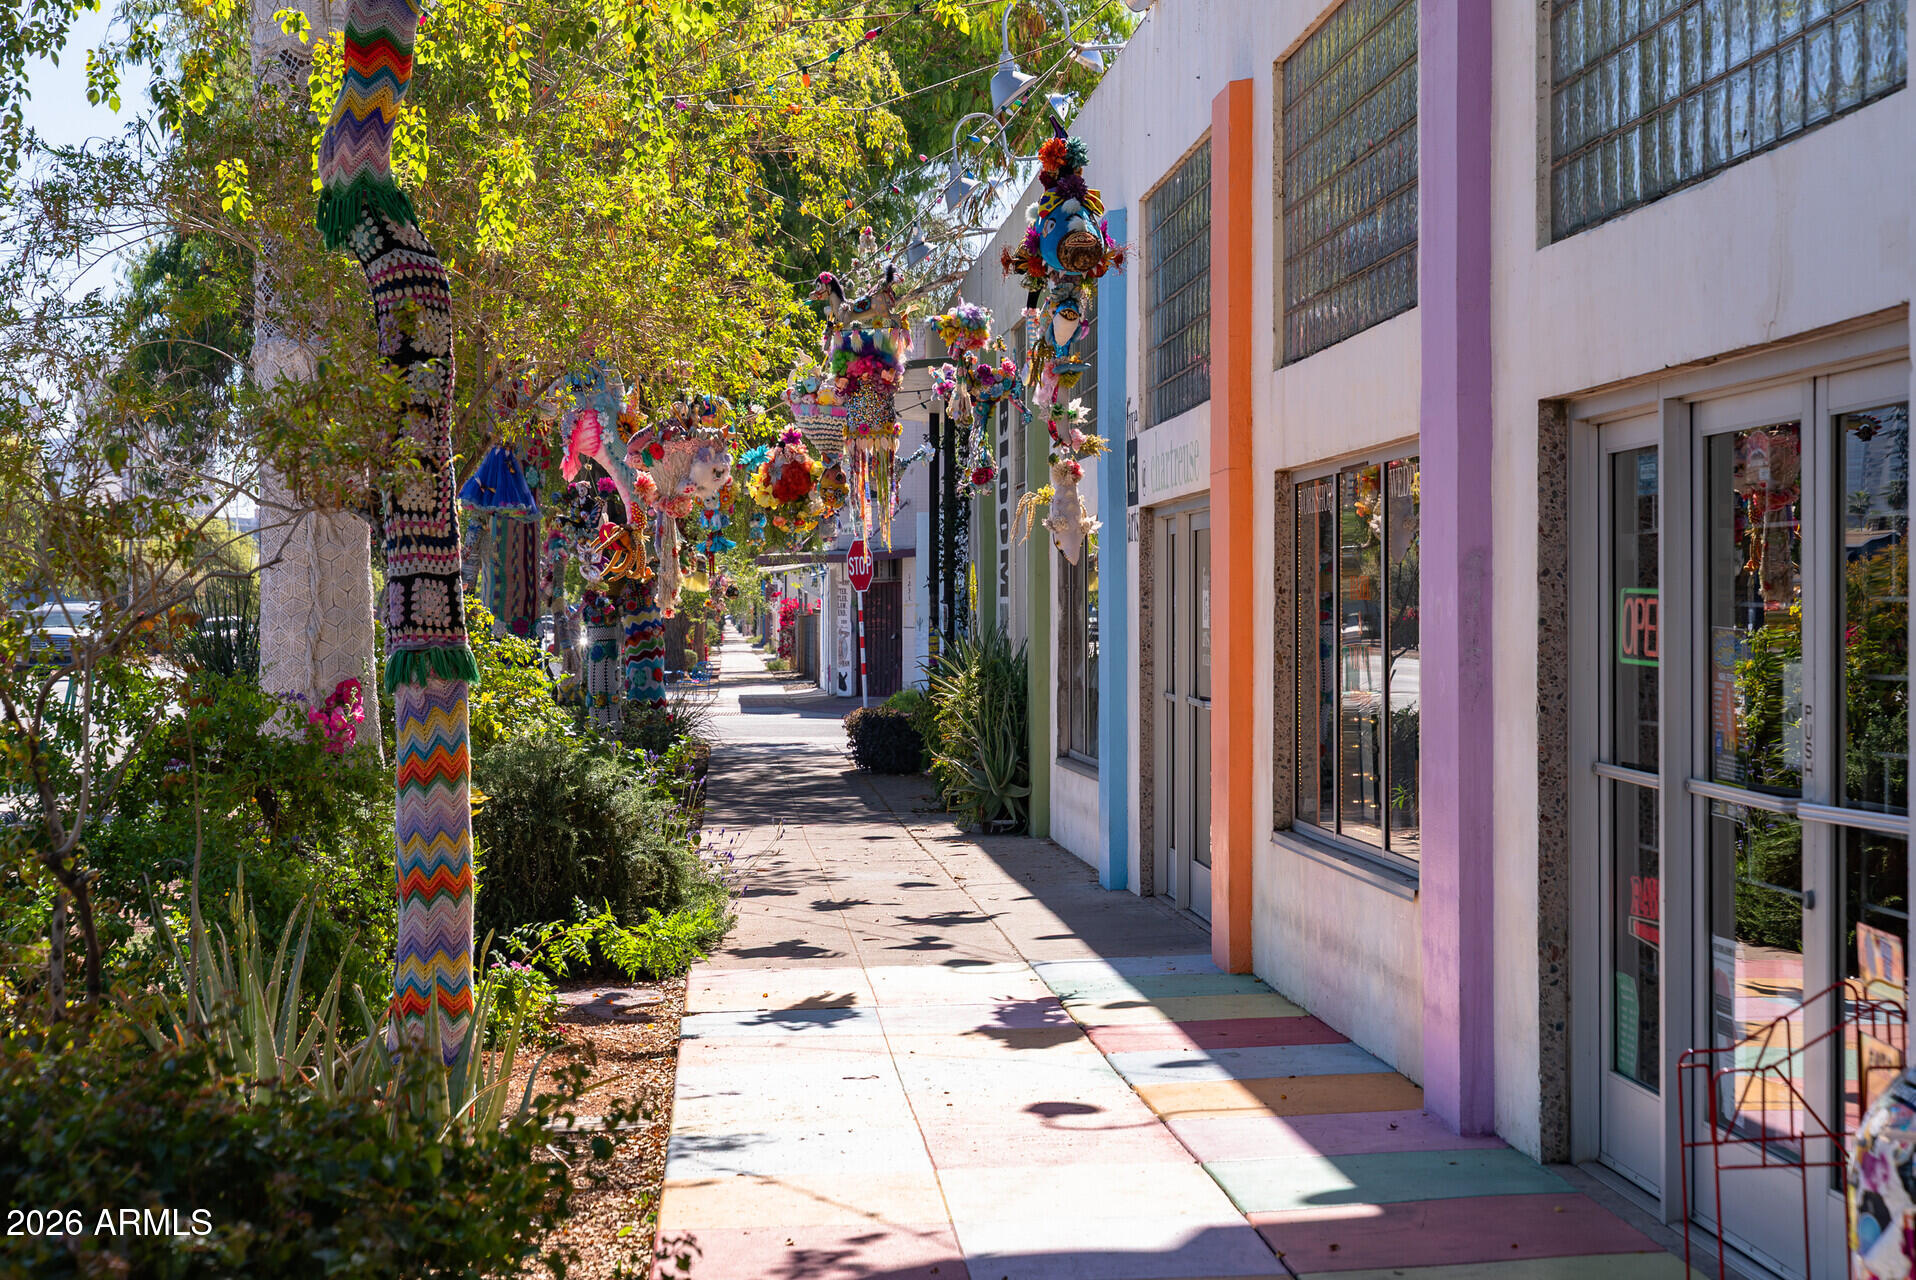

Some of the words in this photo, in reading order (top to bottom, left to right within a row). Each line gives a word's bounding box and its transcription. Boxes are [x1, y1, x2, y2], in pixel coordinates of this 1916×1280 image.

[1129, 455, 1137, 493] 15
[1151, 431, 1199, 494] chartreuse
[848, 556, 872, 576] STOP
[1622, 598, 1660, 657] OPE
[1805, 705, 1813, 778] PUSH
